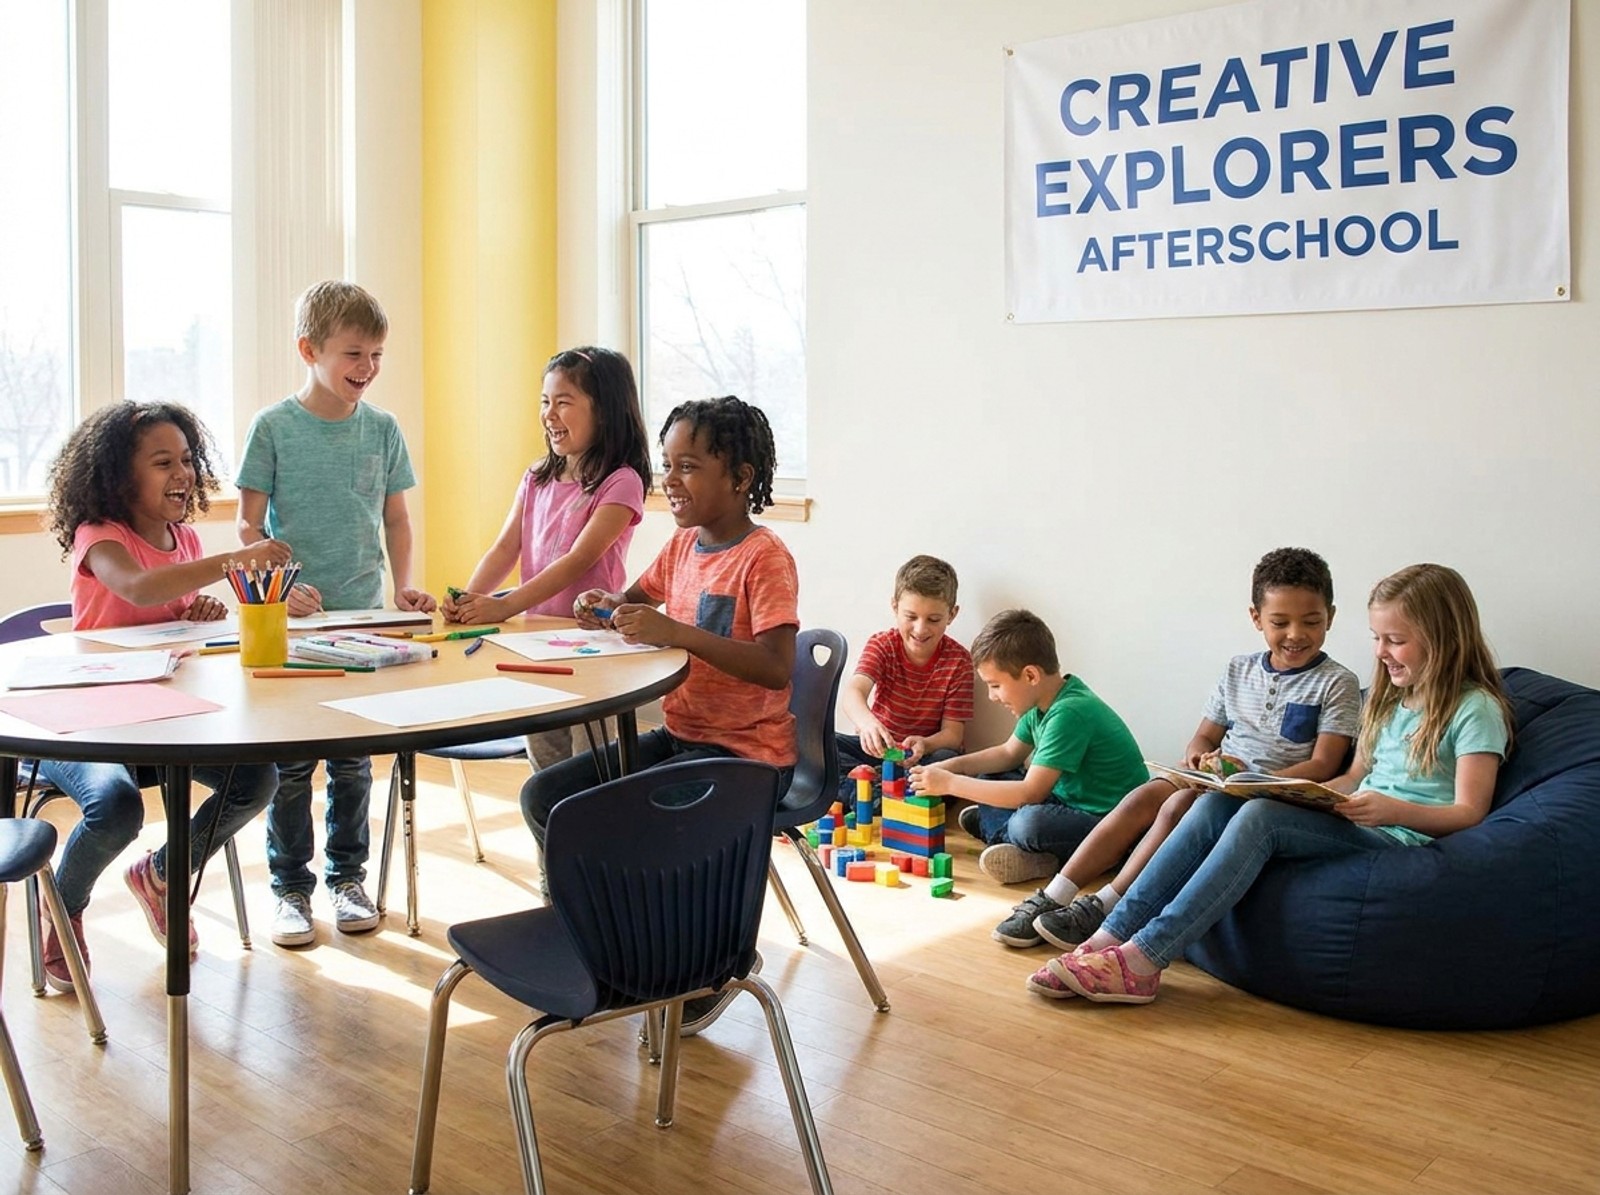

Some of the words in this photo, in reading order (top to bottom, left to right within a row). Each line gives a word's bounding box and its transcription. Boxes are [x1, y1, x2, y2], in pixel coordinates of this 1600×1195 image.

[1060, 20, 1455, 136] CREATIVE
[1035, 105, 1518, 218] EXPLORERS
[1077, 208, 1458, 273] AFTERSCHOOL
